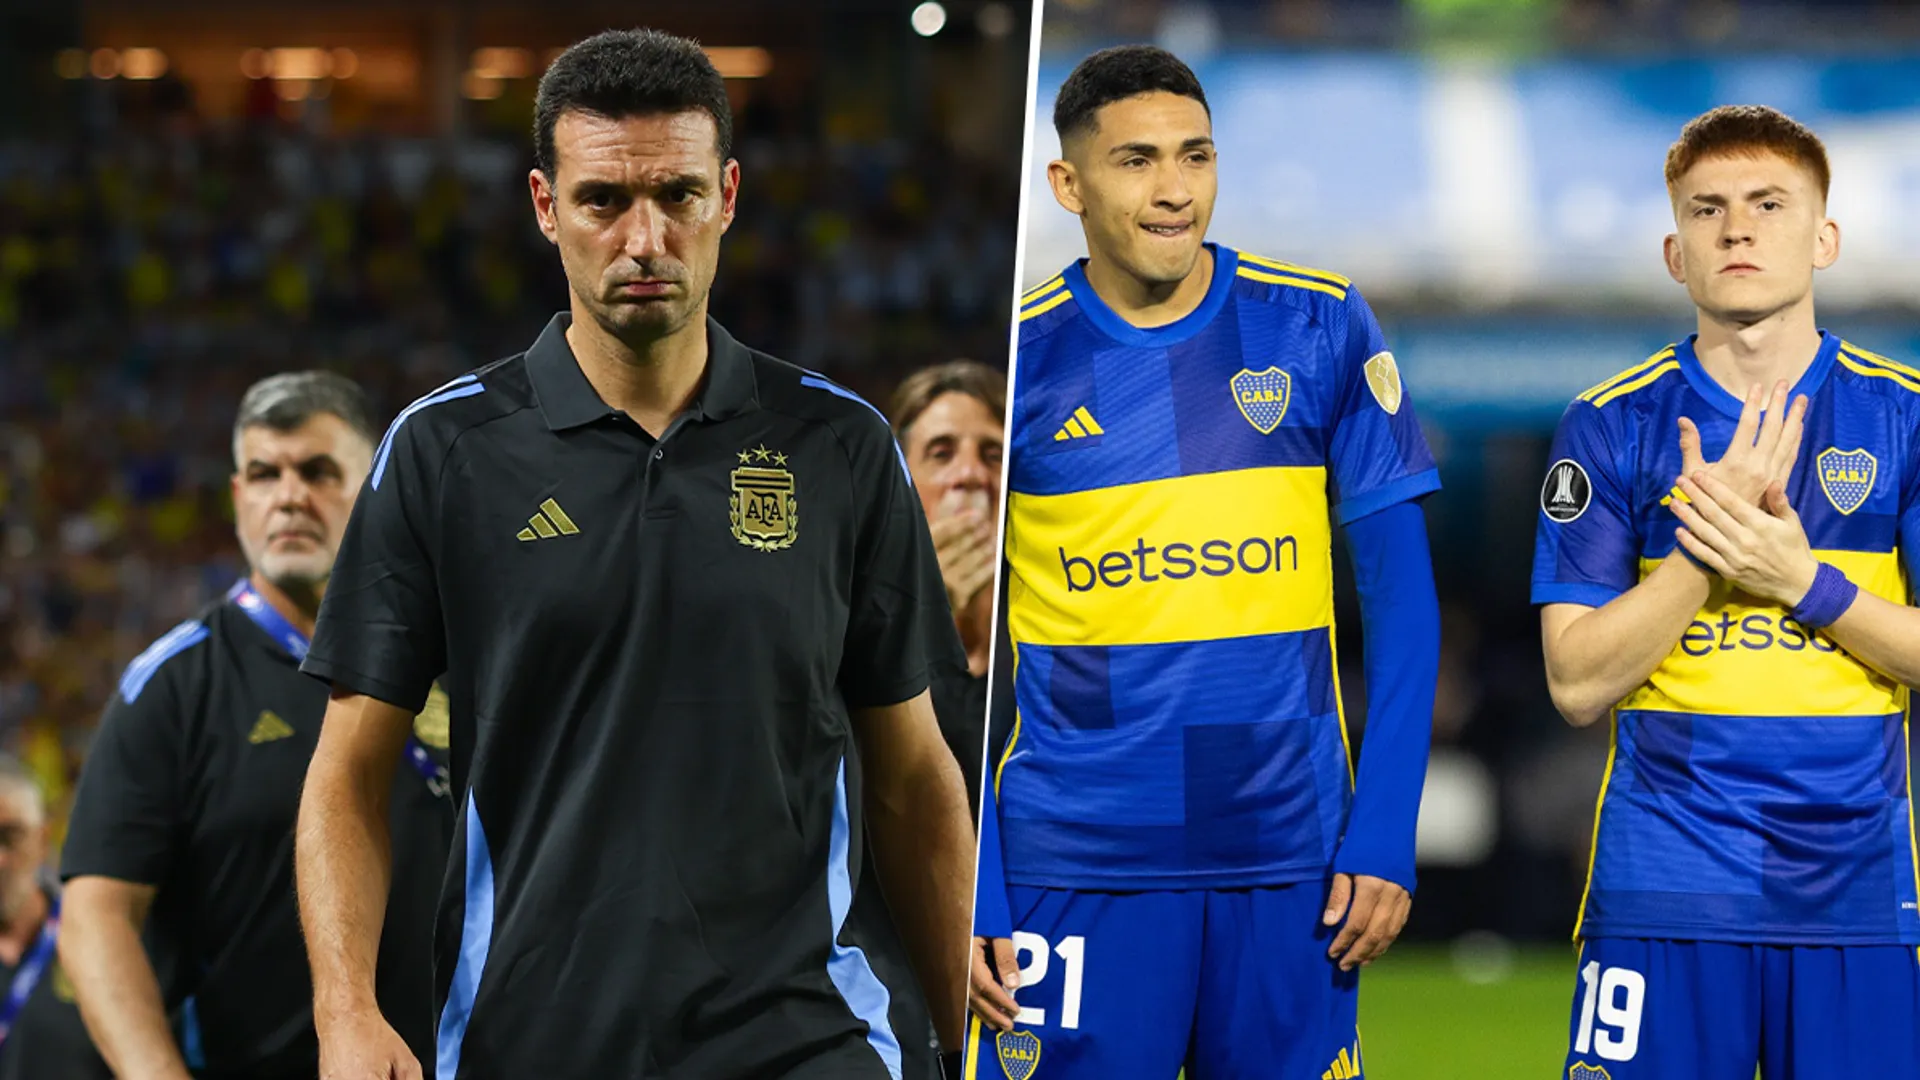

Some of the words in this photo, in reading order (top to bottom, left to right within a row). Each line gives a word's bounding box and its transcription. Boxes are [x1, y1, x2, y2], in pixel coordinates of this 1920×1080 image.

[1241, 389, 1283, 403] CABJ
[1826, 469, 1868, 484] CABJ
[745, 490, 783, 527] AFA
[1059, 535, 1297, 592] betsson
[1002, 930, 1085, 1029] 21
[1575, 960, 1646, 1062] 19
[1003, 1047, 1034, 1061] CABJ
